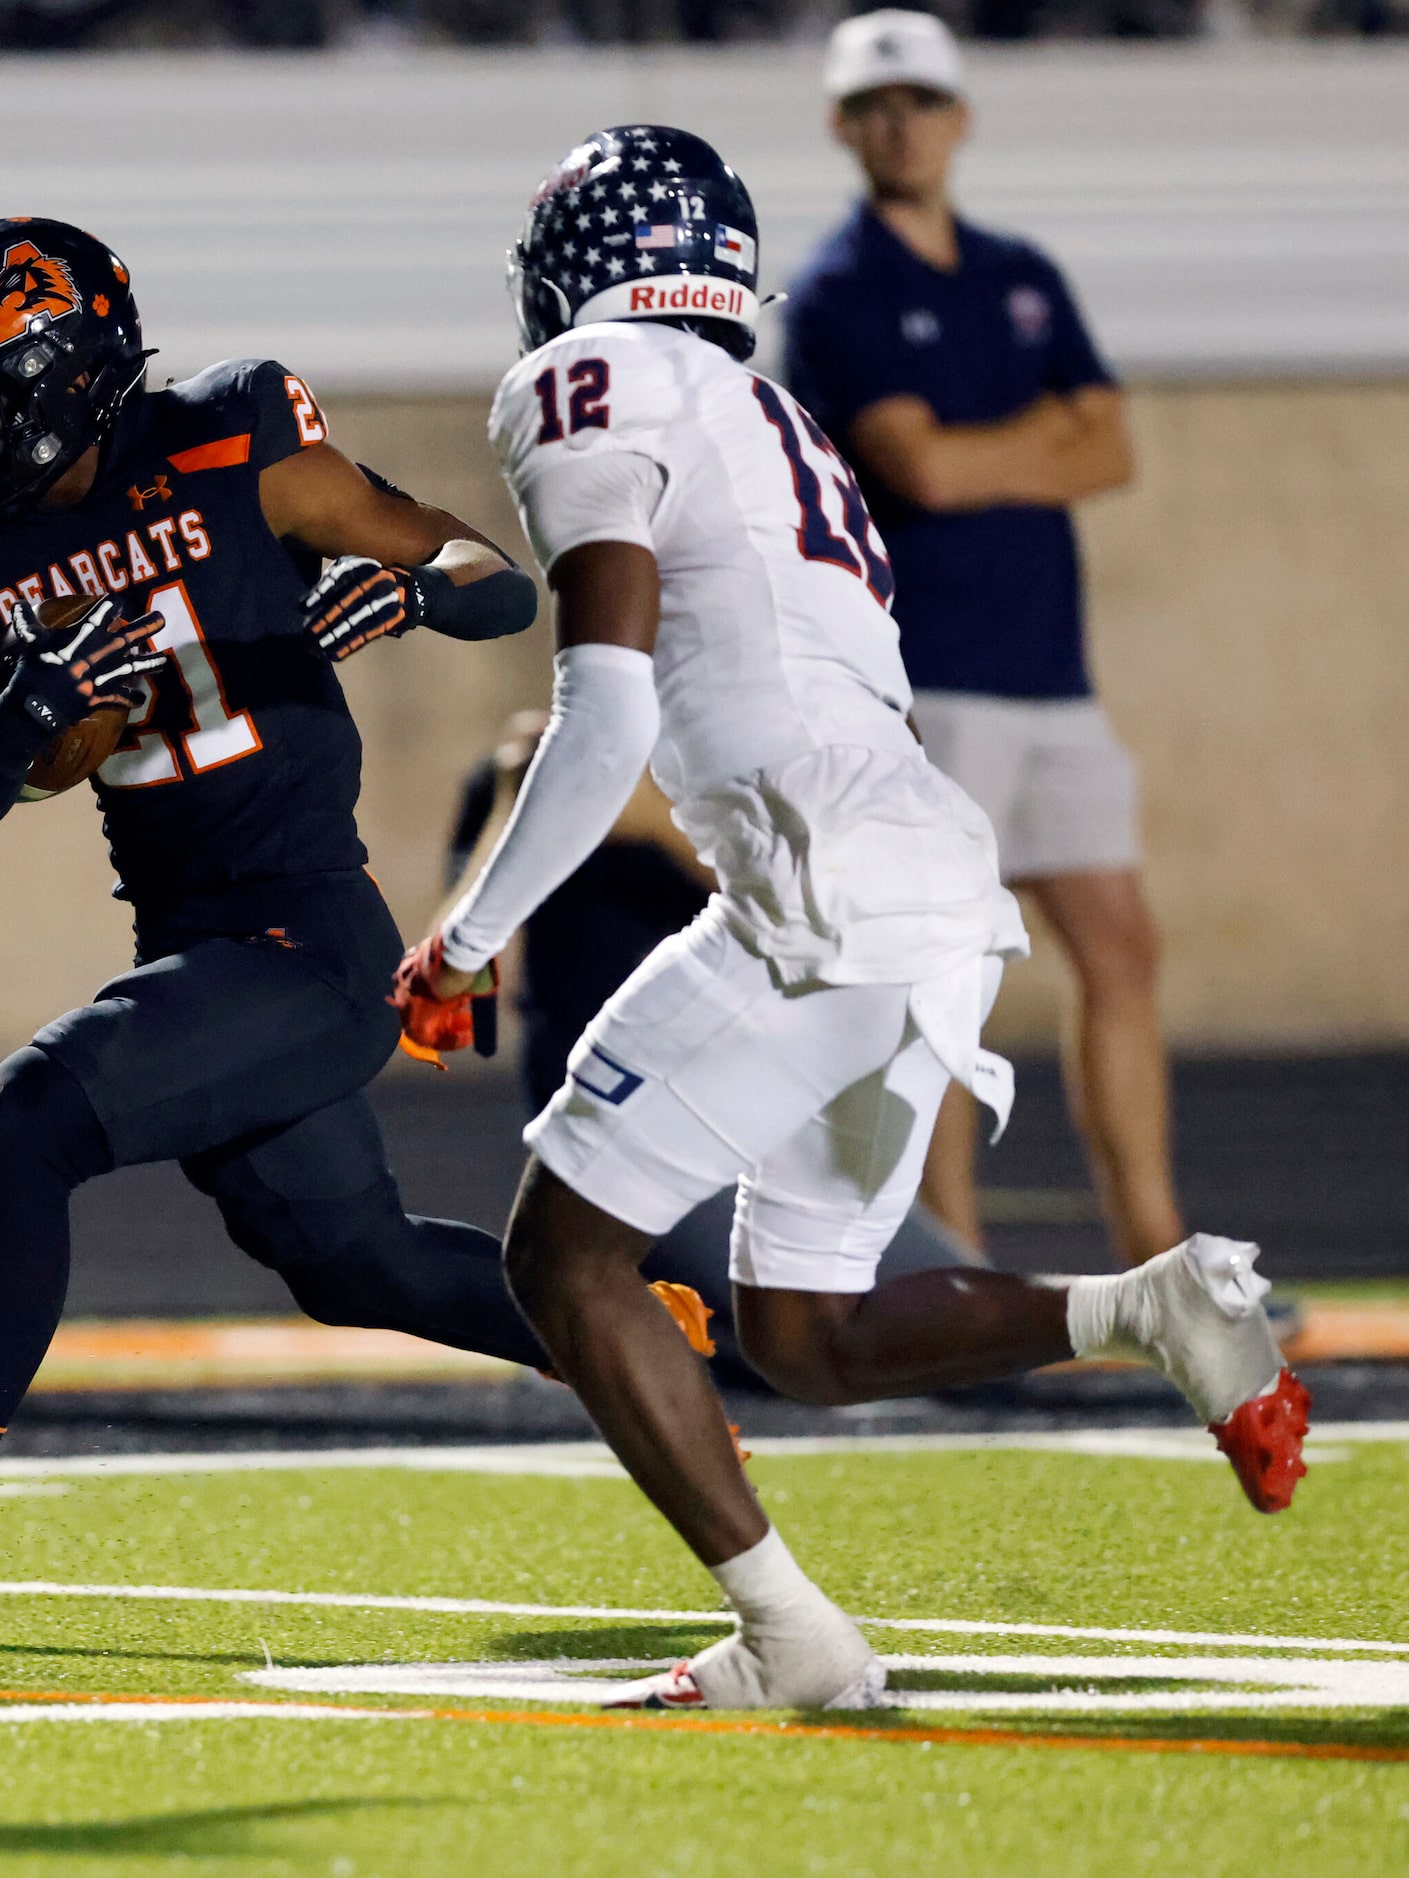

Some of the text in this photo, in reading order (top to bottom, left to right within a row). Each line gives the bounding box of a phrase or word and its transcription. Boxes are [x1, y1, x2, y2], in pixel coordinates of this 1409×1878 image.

[678, 196, 706, 220] 12
[630, 284, 742, 316] Riddell
[535, 358, 610, 445] 12
